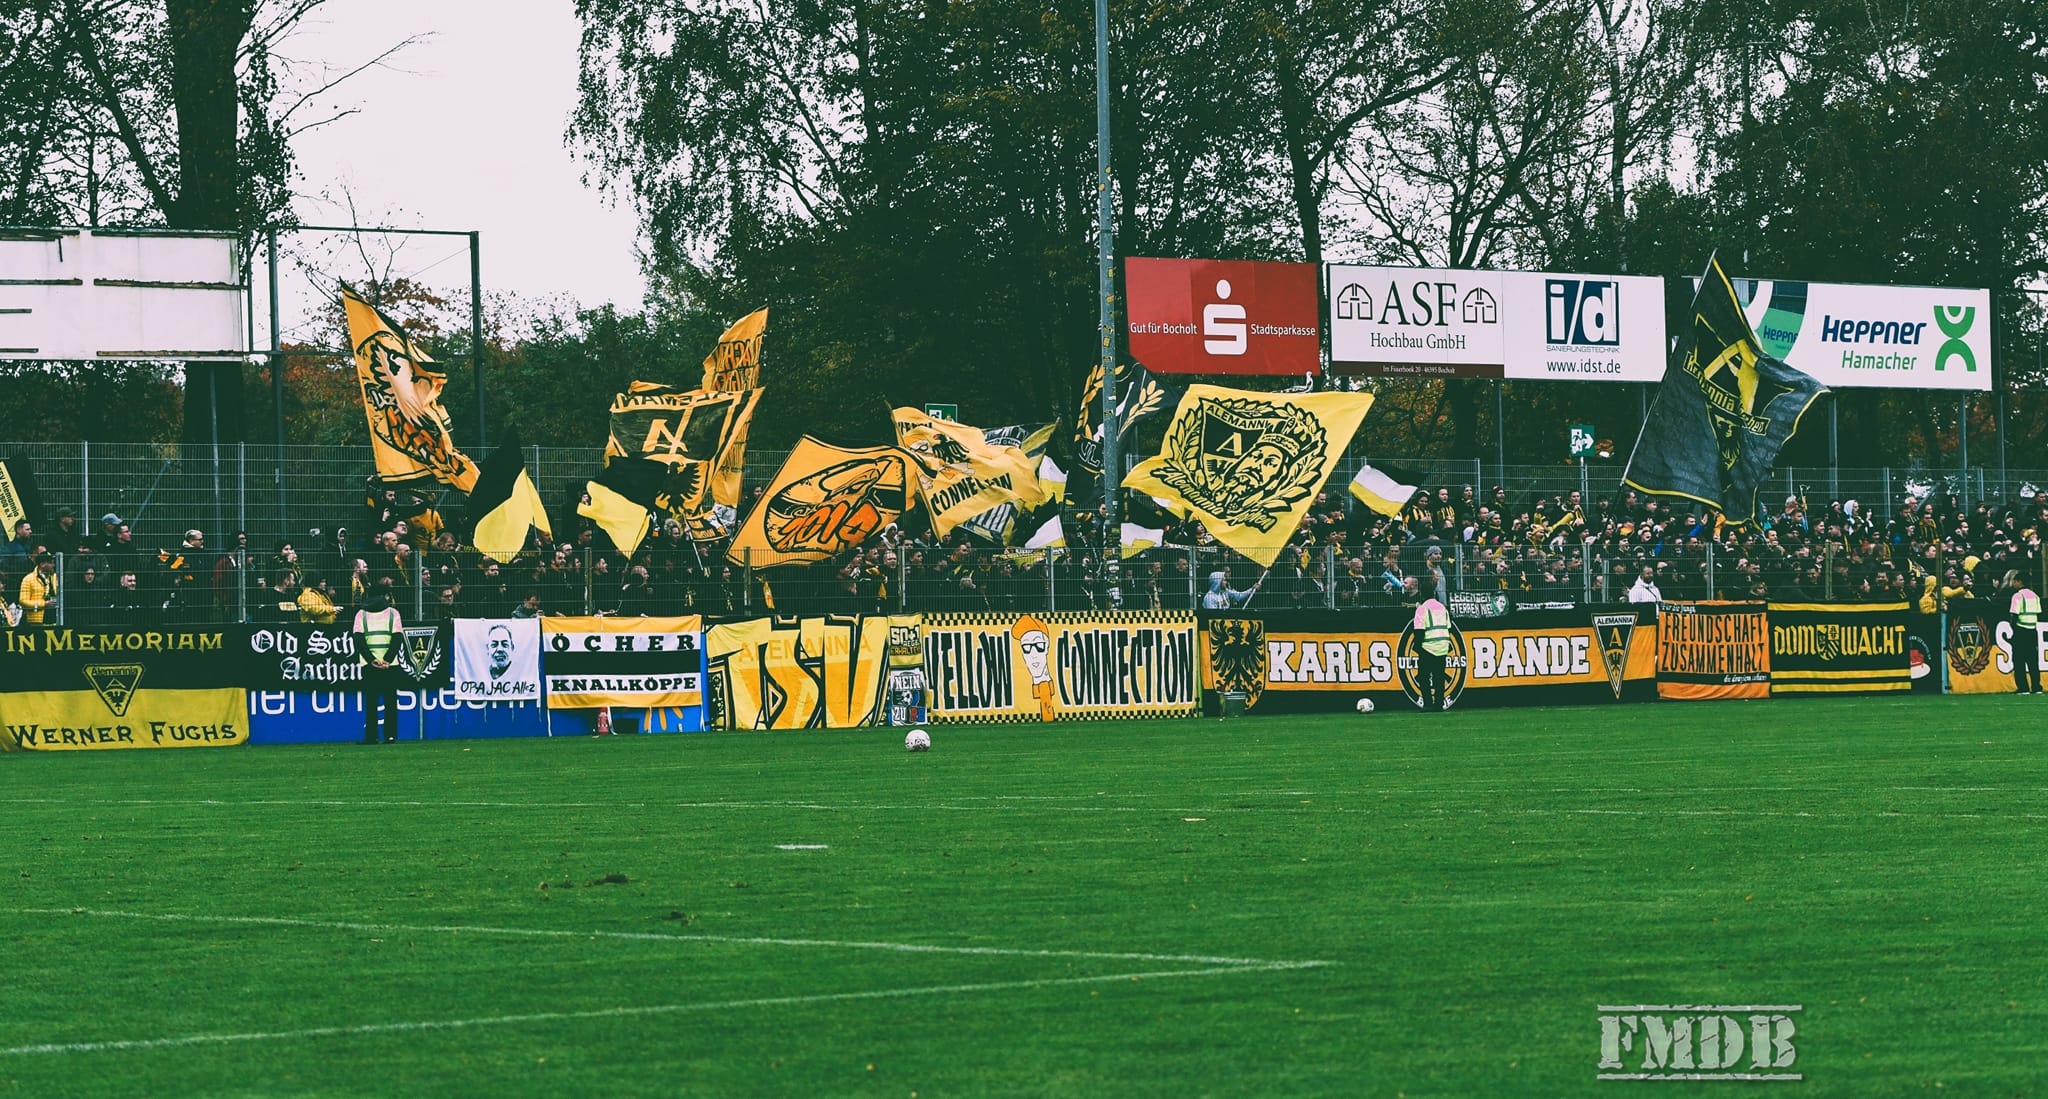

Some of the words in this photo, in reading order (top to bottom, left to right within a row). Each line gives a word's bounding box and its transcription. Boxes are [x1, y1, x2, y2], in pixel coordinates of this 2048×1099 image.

[1378, 280, 1457, 326] ASF
[1130, 322, 1147, 334] Gut
[1148, 322, 1162, 334] für
[1163, 323, 1197, 335] Bocholt
[1251, 324, 1316, 337] Stadtsparkasse
[1371, 333, 1423, 349] Hochbau
[1427, 334, 1466, 350] GmbH
[1547, 358, 1621, 373] www.idst.de
[1842, 350, 1917, 371] Hamacher
[1597, 617, 1633, 625] ALEMANNIA
[1664, 612, 1763, 643] FREUNDSCHAFT
[44, 629, 224, 656] MEMORIAM
[251, 629, 299, 655] Old
[1609, 627, 1622, 647] A
[924, 629, 1014, 711] YELLOW
[1056, 627, 1194, 706] CONNECTION
[1268, 641, 1393, 683] KARLS
[1472, 636, 1590, 679] BANDE
[1661, 641, 1765, 672] ZUSAMMENHALT
[280, 656, 363, 684] Aachen
[705, 615, 889, 730] TSV
[895, 674, 920, 690] NEIN
[461, 681, 485, 695] OPA
[486, 681, 511, 696] JAC
[551, 676, 696, 692] KNALLKÖPPE
[7, 723, 135, 747] WERNER
[149, 720, 238, 744] FUCHS
